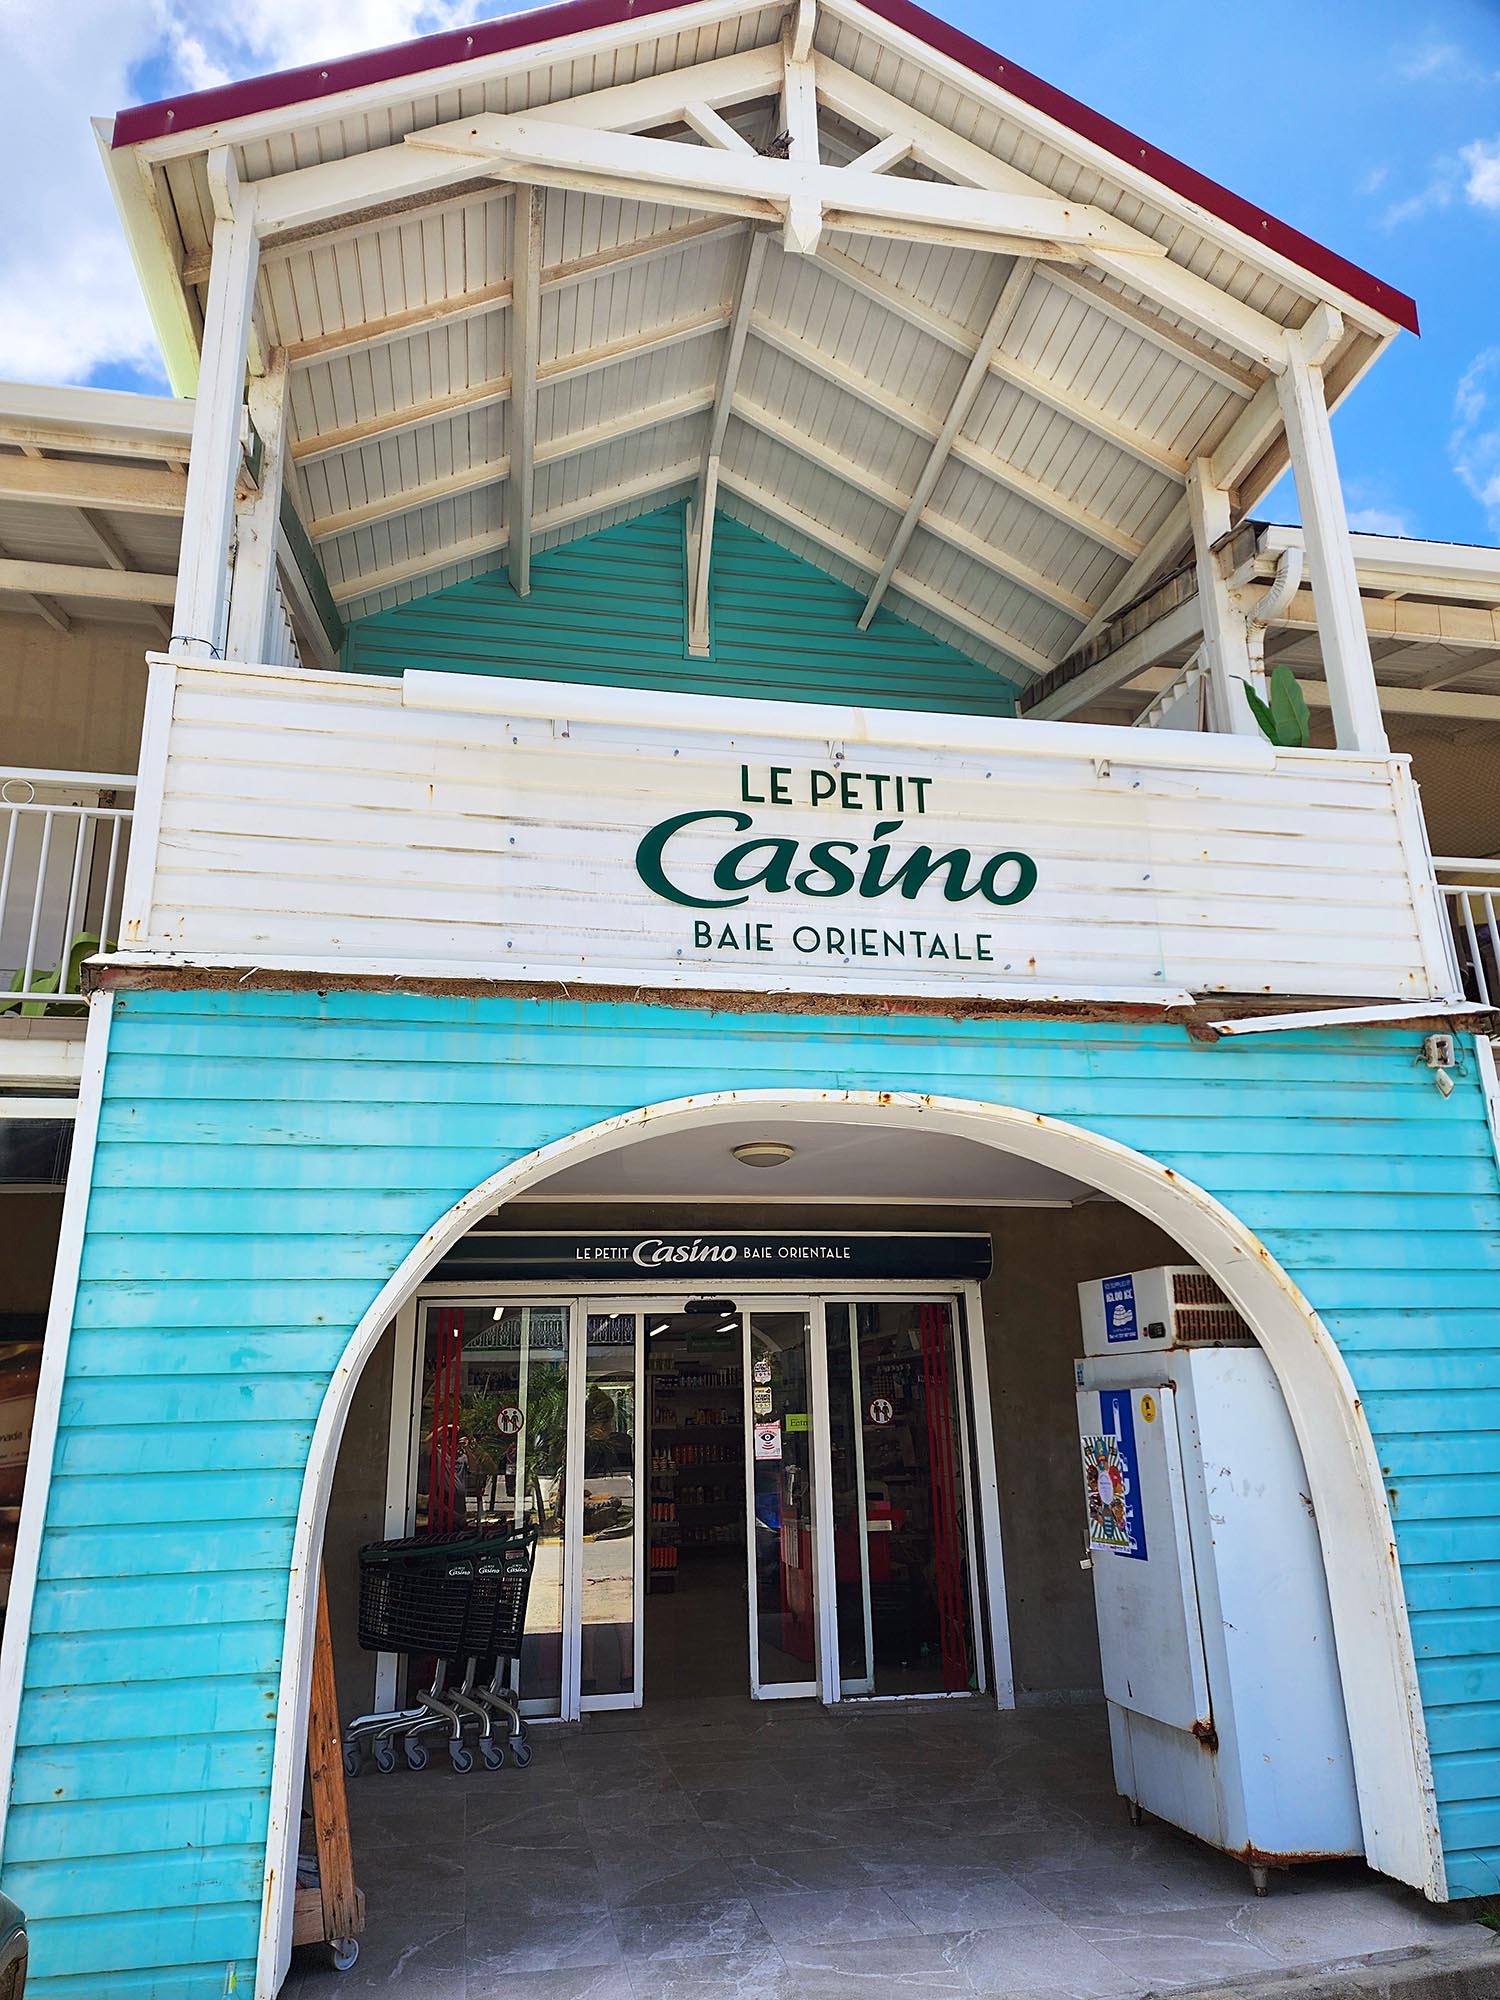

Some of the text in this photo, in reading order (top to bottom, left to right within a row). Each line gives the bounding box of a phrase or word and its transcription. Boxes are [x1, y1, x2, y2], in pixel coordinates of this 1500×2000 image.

[741, 764, 933, 814] LE PETIT
[636, 809, 1038, 909] Casino
[694, 920, 994, 962] BAIE ORIENTALE
[576, 1238, 851, 1268] LE PETIT Casino BAIE ORIENTALE
